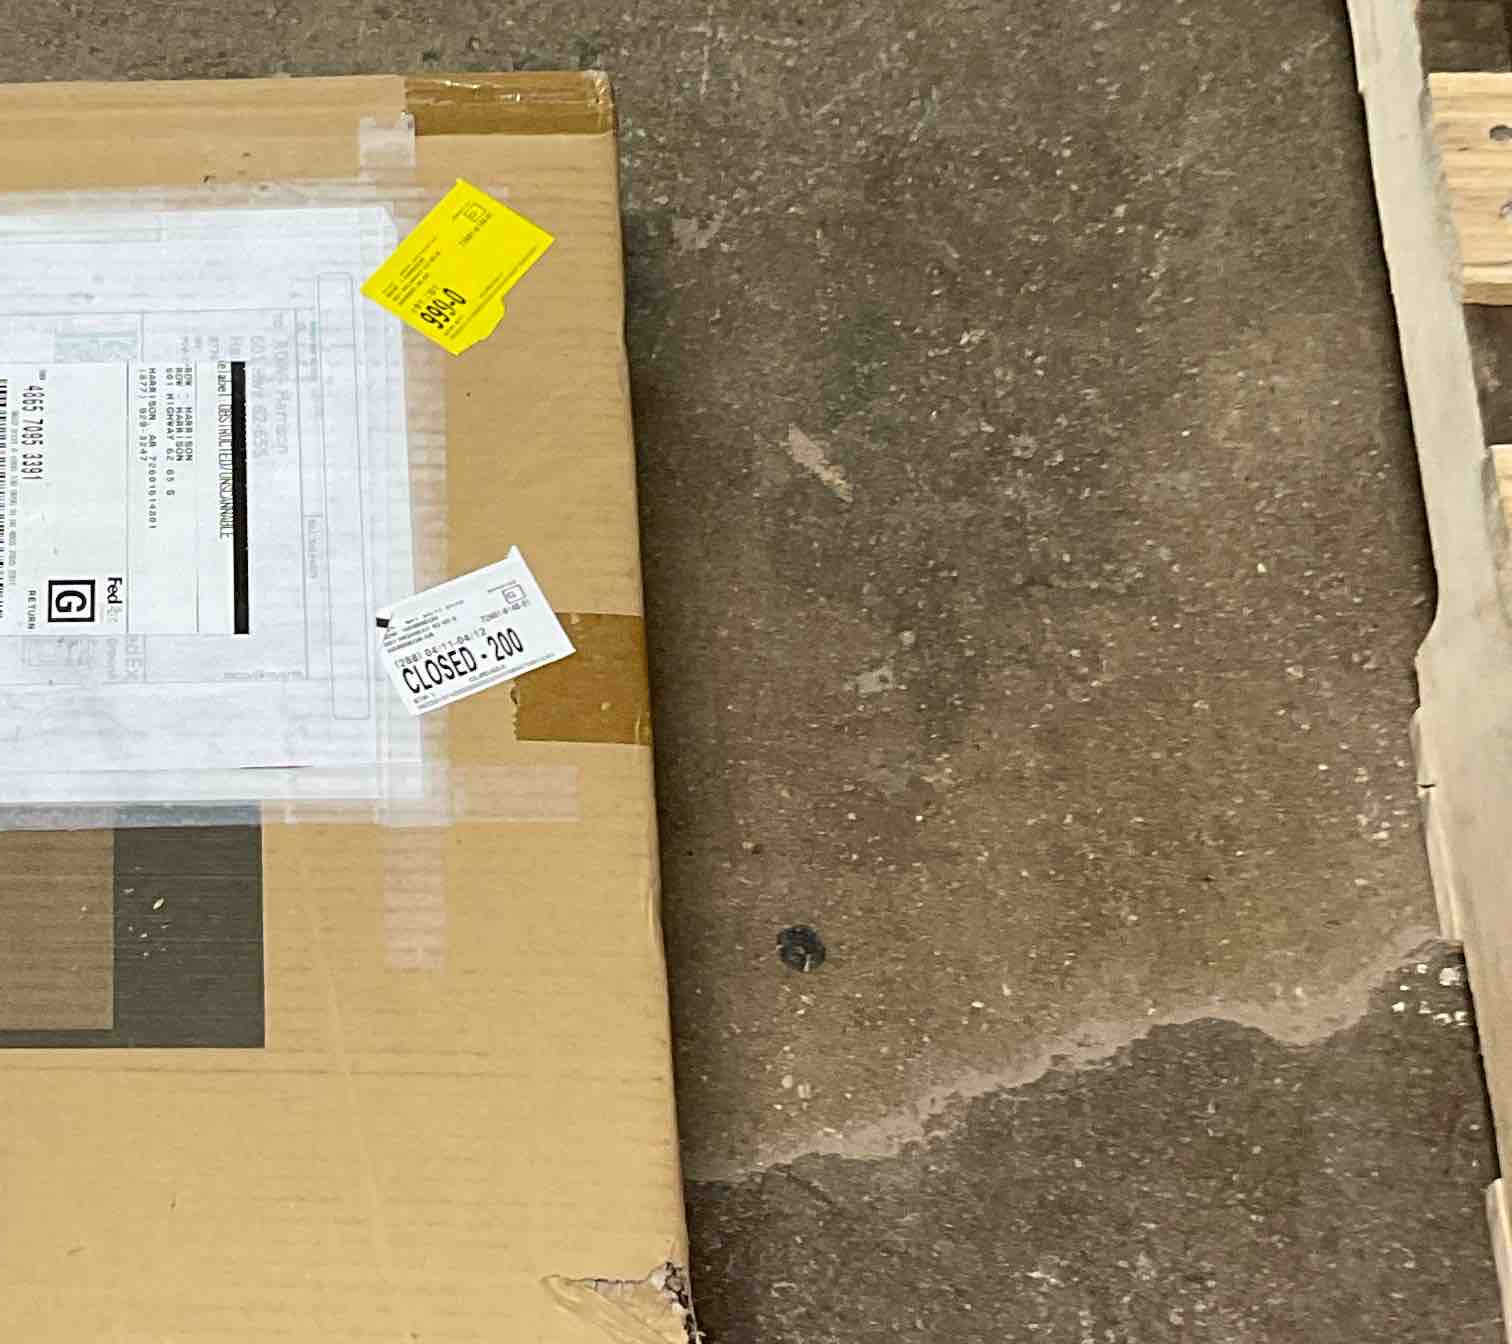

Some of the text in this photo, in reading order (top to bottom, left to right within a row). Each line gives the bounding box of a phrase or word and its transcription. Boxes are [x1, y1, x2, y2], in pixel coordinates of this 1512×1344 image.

[21, 385, 45, 412] 4865
[175, 407, 184, 461] HARRISON
[185, 407, 193, 461] HARRISON
[21, 453, 44, 480] 3391
[27, 590, 37, 630] RETURN
[55, 590, 88, 613] G
[402, 646, 477, 694] CLOSED
[488, 627, 524, 661] 200
